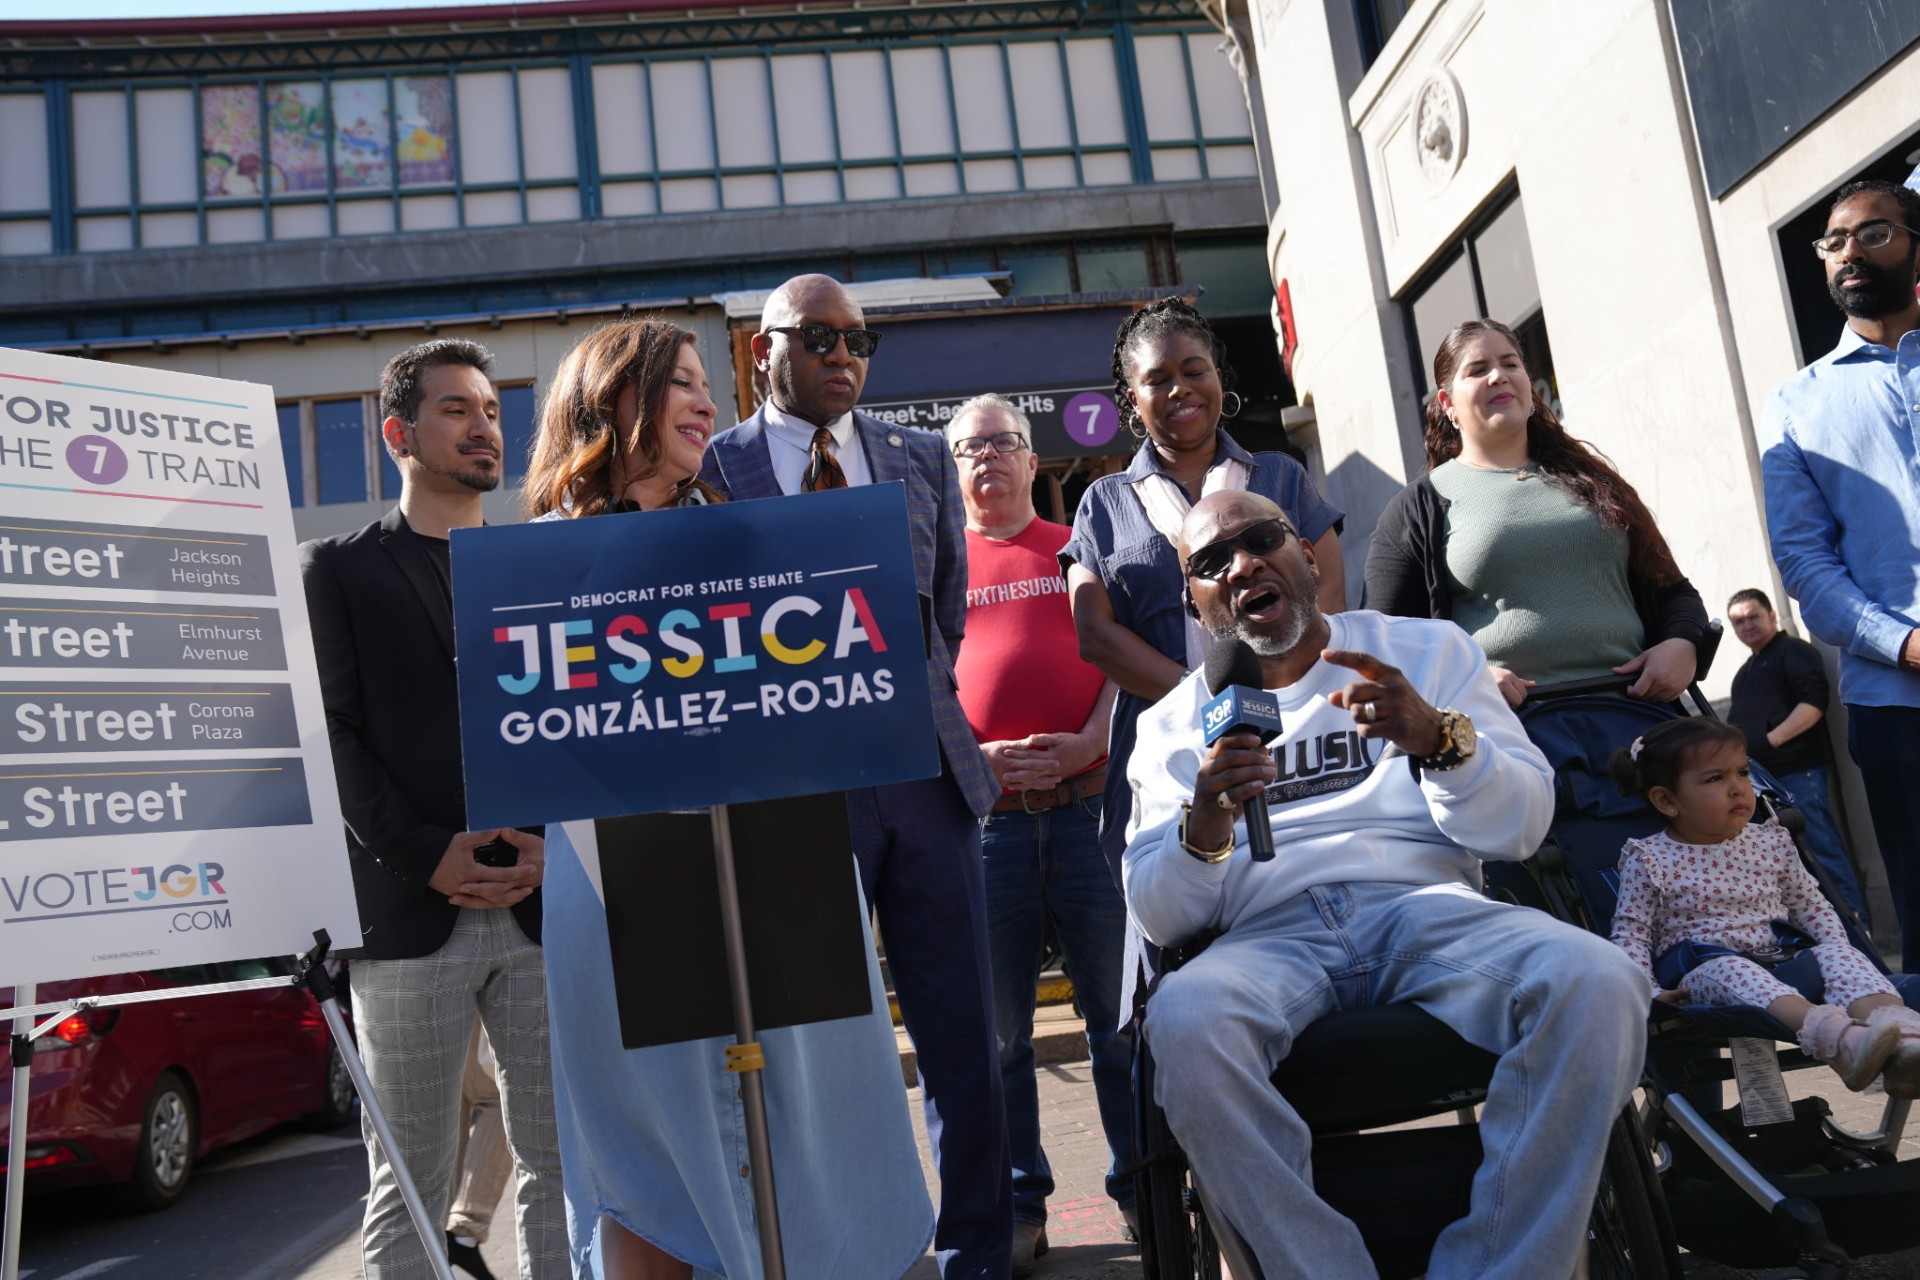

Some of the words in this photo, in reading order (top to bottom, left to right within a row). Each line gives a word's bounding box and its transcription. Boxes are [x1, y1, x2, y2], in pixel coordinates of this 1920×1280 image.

[0, 394, 71, 428] OR
[90, 405, 254, 449] JUSTICE
[1079, 404, 1101, 435] 7
[85, 445, 108, 475] 7
[138, 450, 261, 489] TRAIN
[169, 548, 241, 566] Jackson
[172, 568, 240, 586] Heights
[570, 588, 655, 609] DEMOCRAT
[661, 583, 694, 599] FOR
[700, 578, 743, 595] STATE
[749, 571, 803, 589] SENATE
[4, 619, 133, 658] treet
[179, 624, 262, 641] Elmhurst
[493, 587, 889, 695] JESSICA
[182, 646, 248, 661] Avenue
[15, 703, 176, 742] Street
[189, 703, 254, 718] Corona
[1205, 699, 1232, 729] JGR
[192, 725, 243, 740] Plaza
[24, 782, 187, 829] Street
[168, 909, 231, 933] .COM
